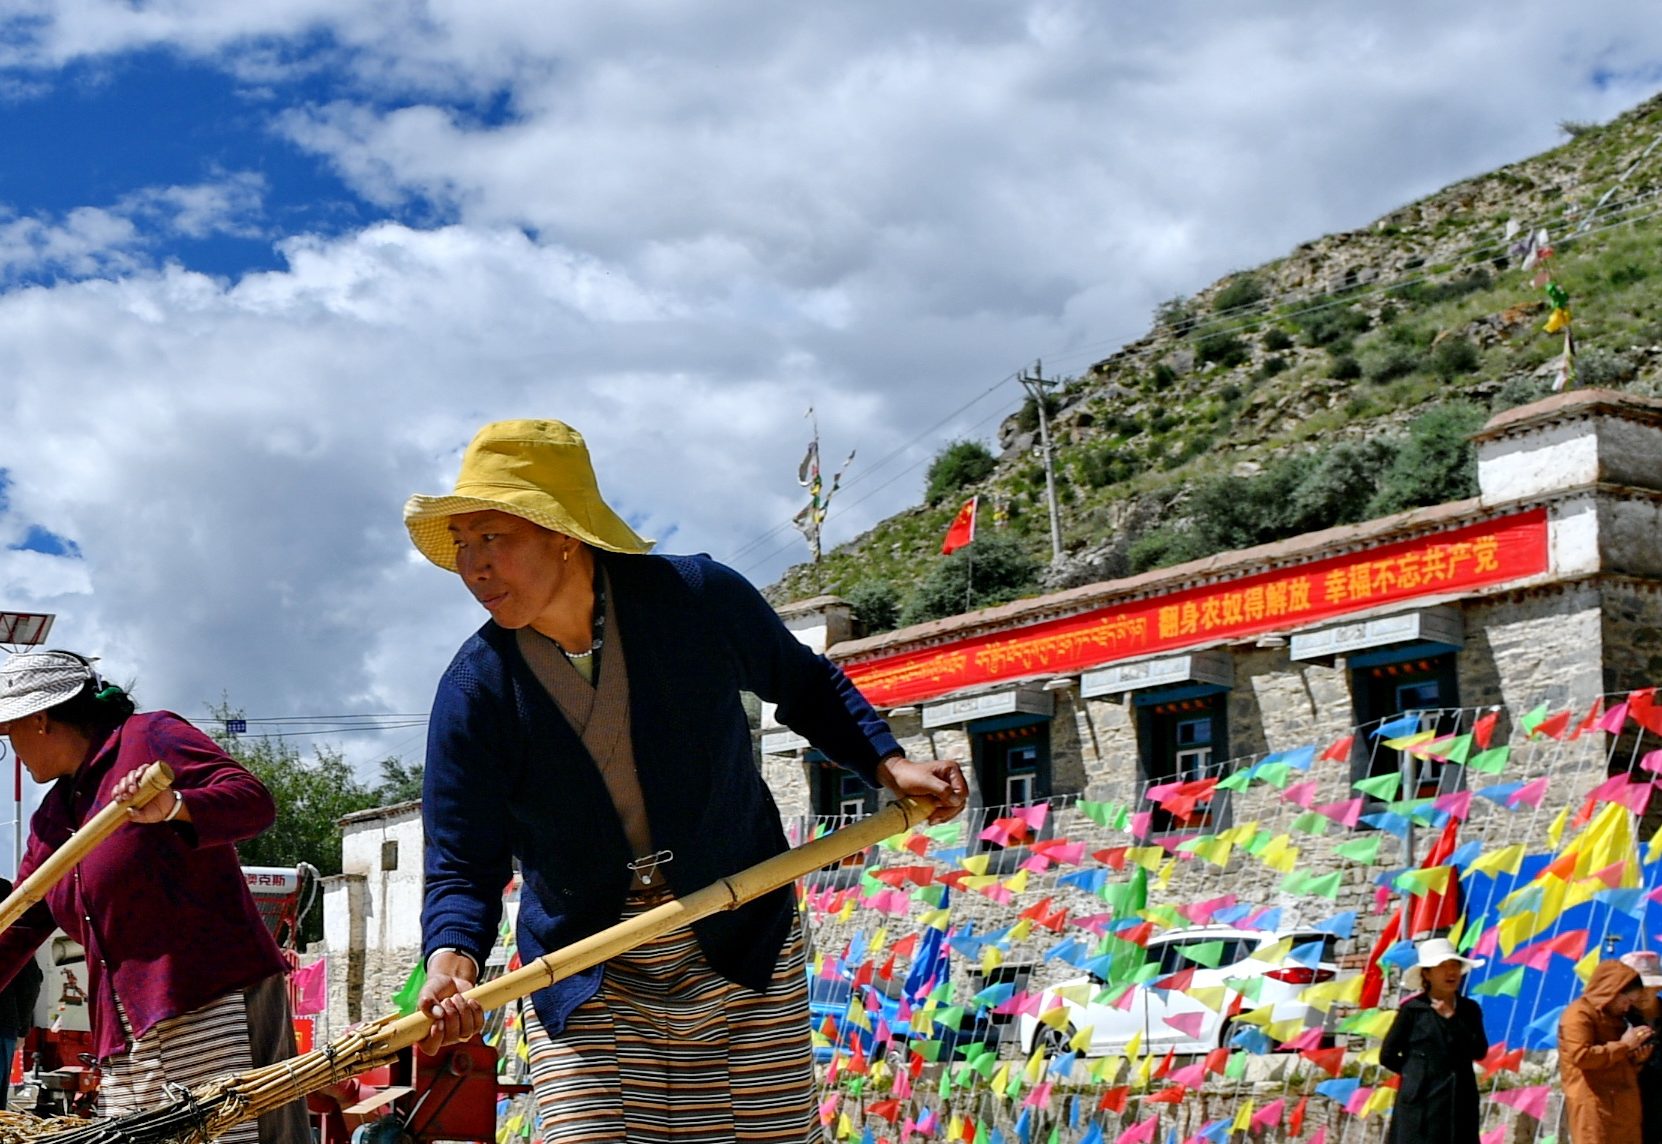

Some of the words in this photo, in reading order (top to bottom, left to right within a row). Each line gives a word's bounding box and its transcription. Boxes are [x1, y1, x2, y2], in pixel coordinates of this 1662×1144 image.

[1158, 578, 1311, 640] 翻身农奴得解放
[1324, 535, 1500, 604] 幸福不忘共产党
